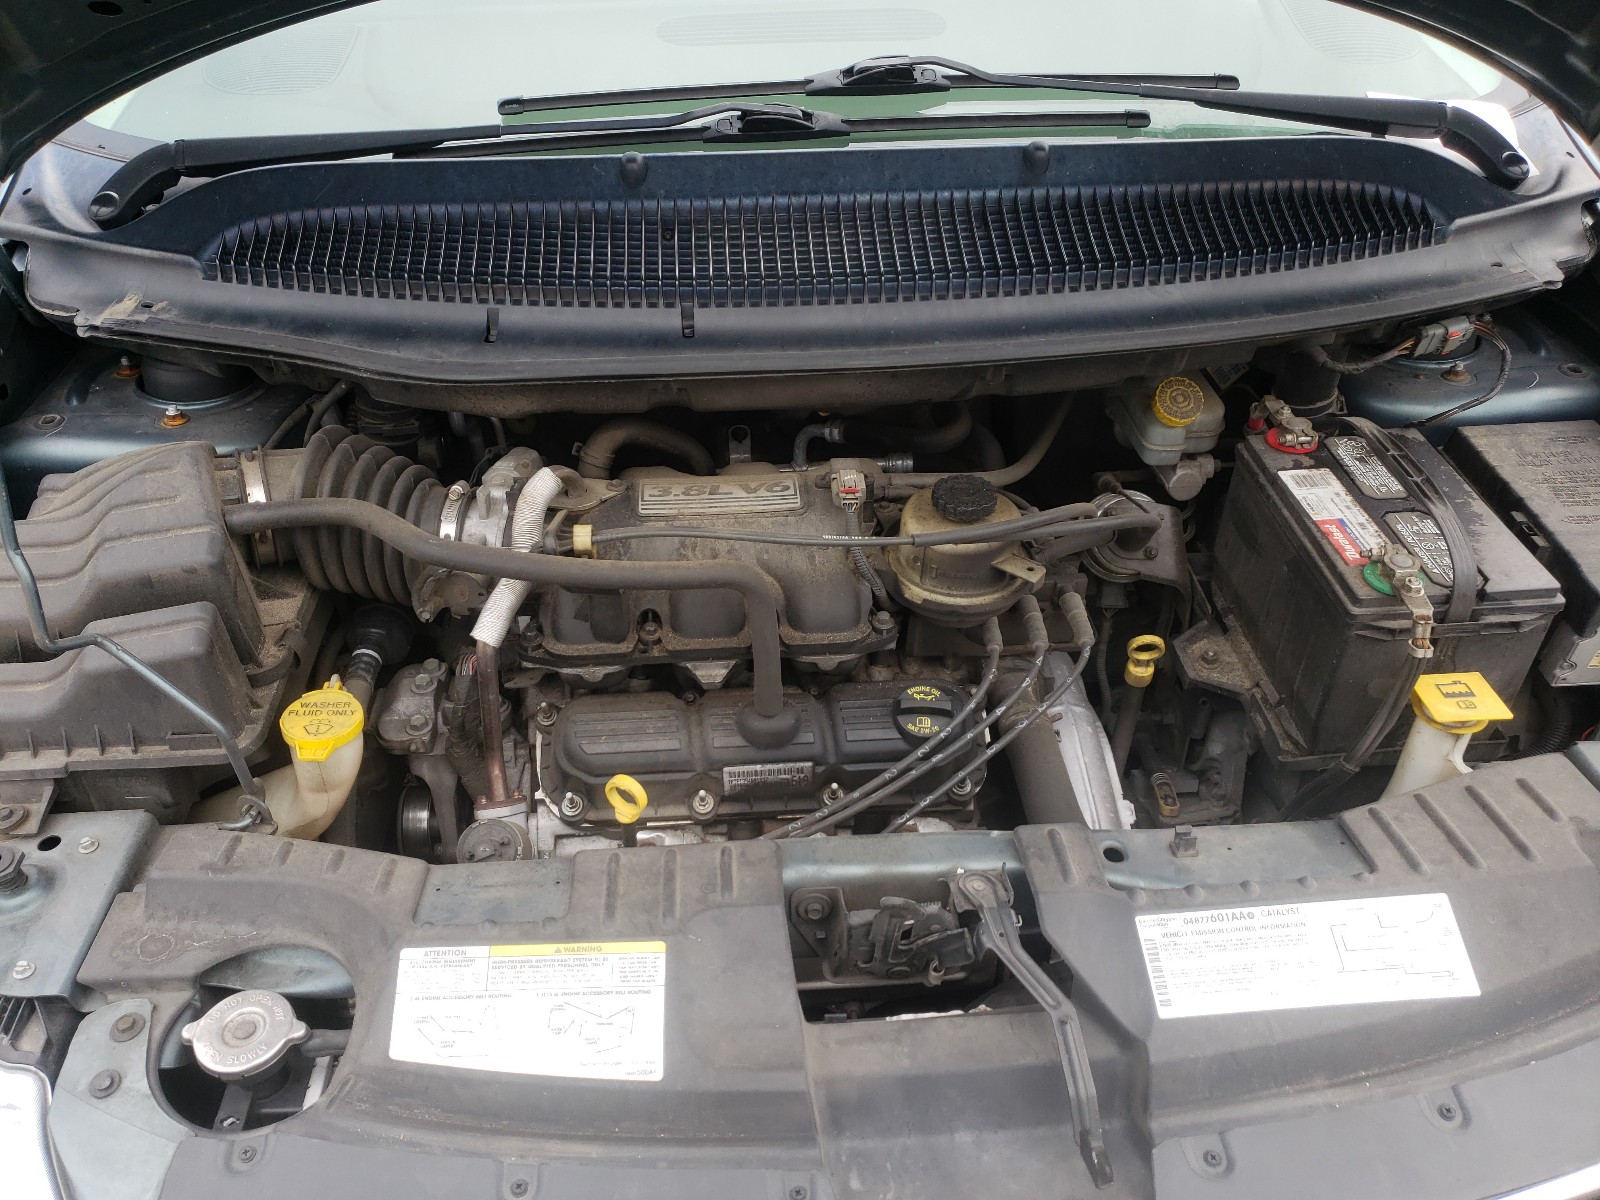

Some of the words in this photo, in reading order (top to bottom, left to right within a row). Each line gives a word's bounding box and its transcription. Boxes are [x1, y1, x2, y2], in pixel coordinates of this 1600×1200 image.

[648, 483, 734, 498] 3.8L
[741, 480, 791, 495] V6
[1324, 524, 1360, 561] Duralast
[1022, 677, 1031, 687] 4
[907, 685, 930, 695] ENGINE
[931, 688, 941, 697] OIL
[300, 701, 351, 709] WASHER
[996, 706, 1007, 715] 4
[907, 723, 919, 732] SAE
[941, 727, 952, 739] 2
[918, 746, 930, 757] 2
[885, 769, 897, 780] 2
[815, 809, 829, 819] 2
[1261, 907, 1300, 917] CATALYST
[1226, 925, 1257, 934] CONTROL
[424, 949, 467, 957] ATTENTION
[249, 994, 272, 1006] OPEN
[226, 1043, 268, 1064] SLOWLY
